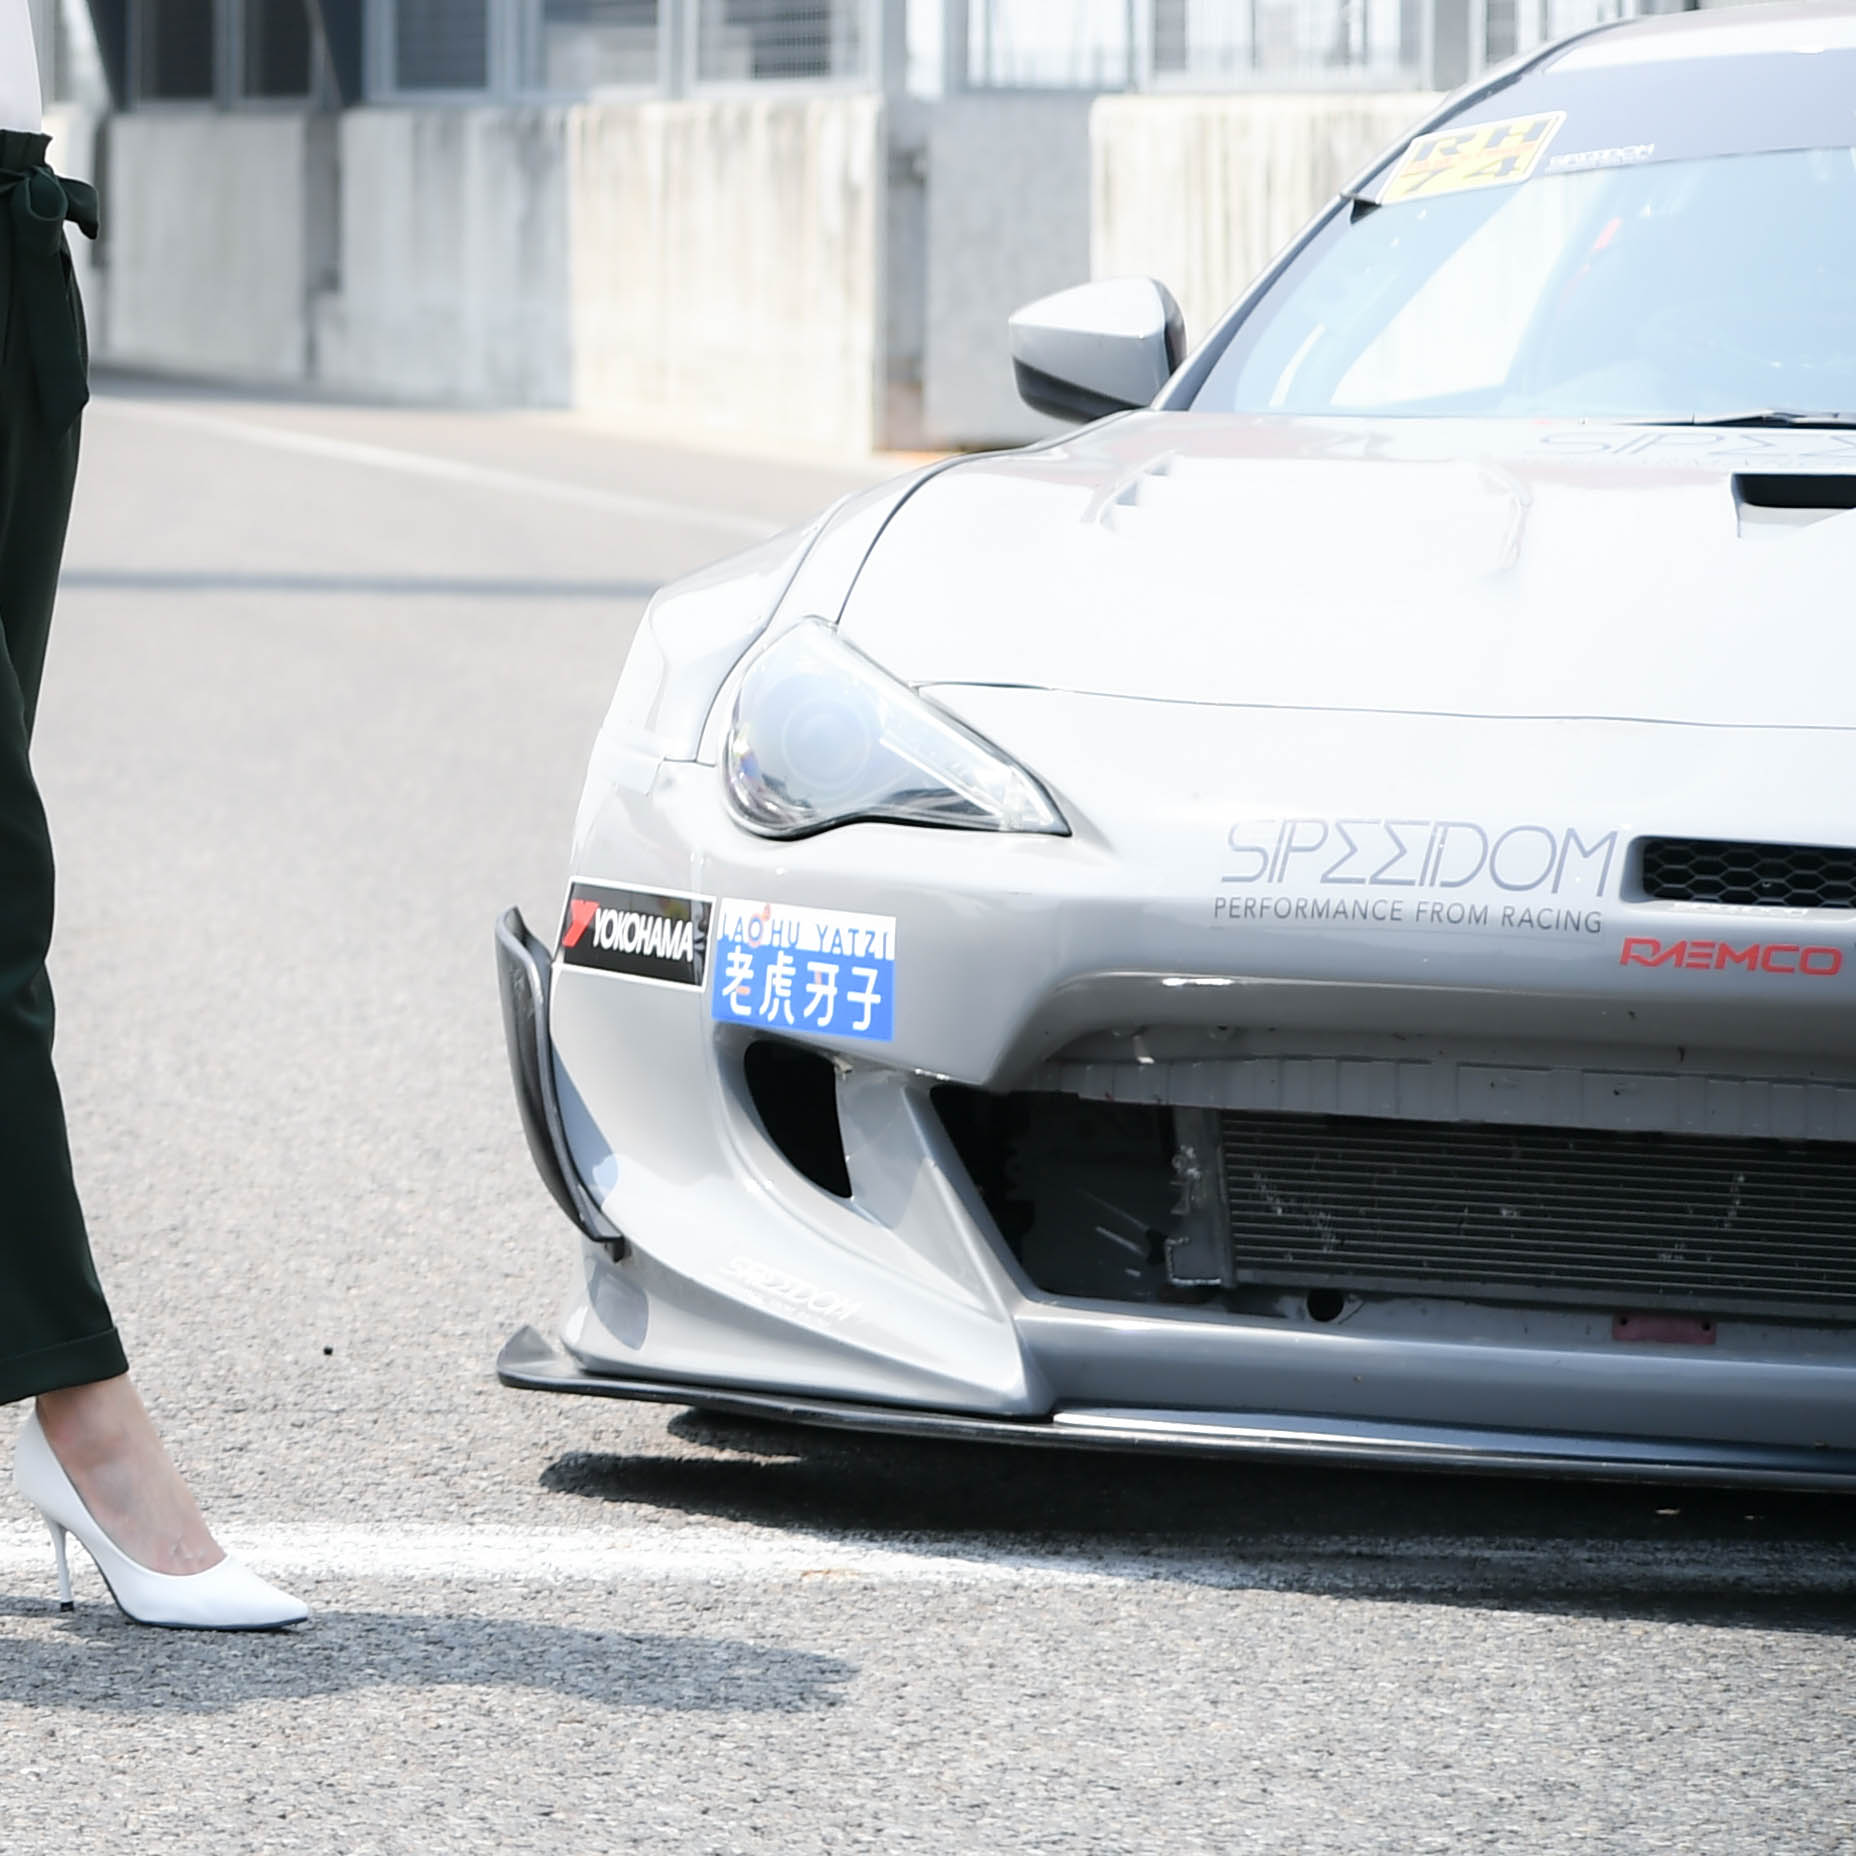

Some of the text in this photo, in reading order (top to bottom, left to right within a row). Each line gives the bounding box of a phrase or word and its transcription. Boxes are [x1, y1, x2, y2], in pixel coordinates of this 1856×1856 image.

[592, 906, 693, 963] YOKOHAMA
[1214, 896, 1602, 934] PERFORMANCE FROM RACING
[719, 945, 882, 1032] 老虎牙子
